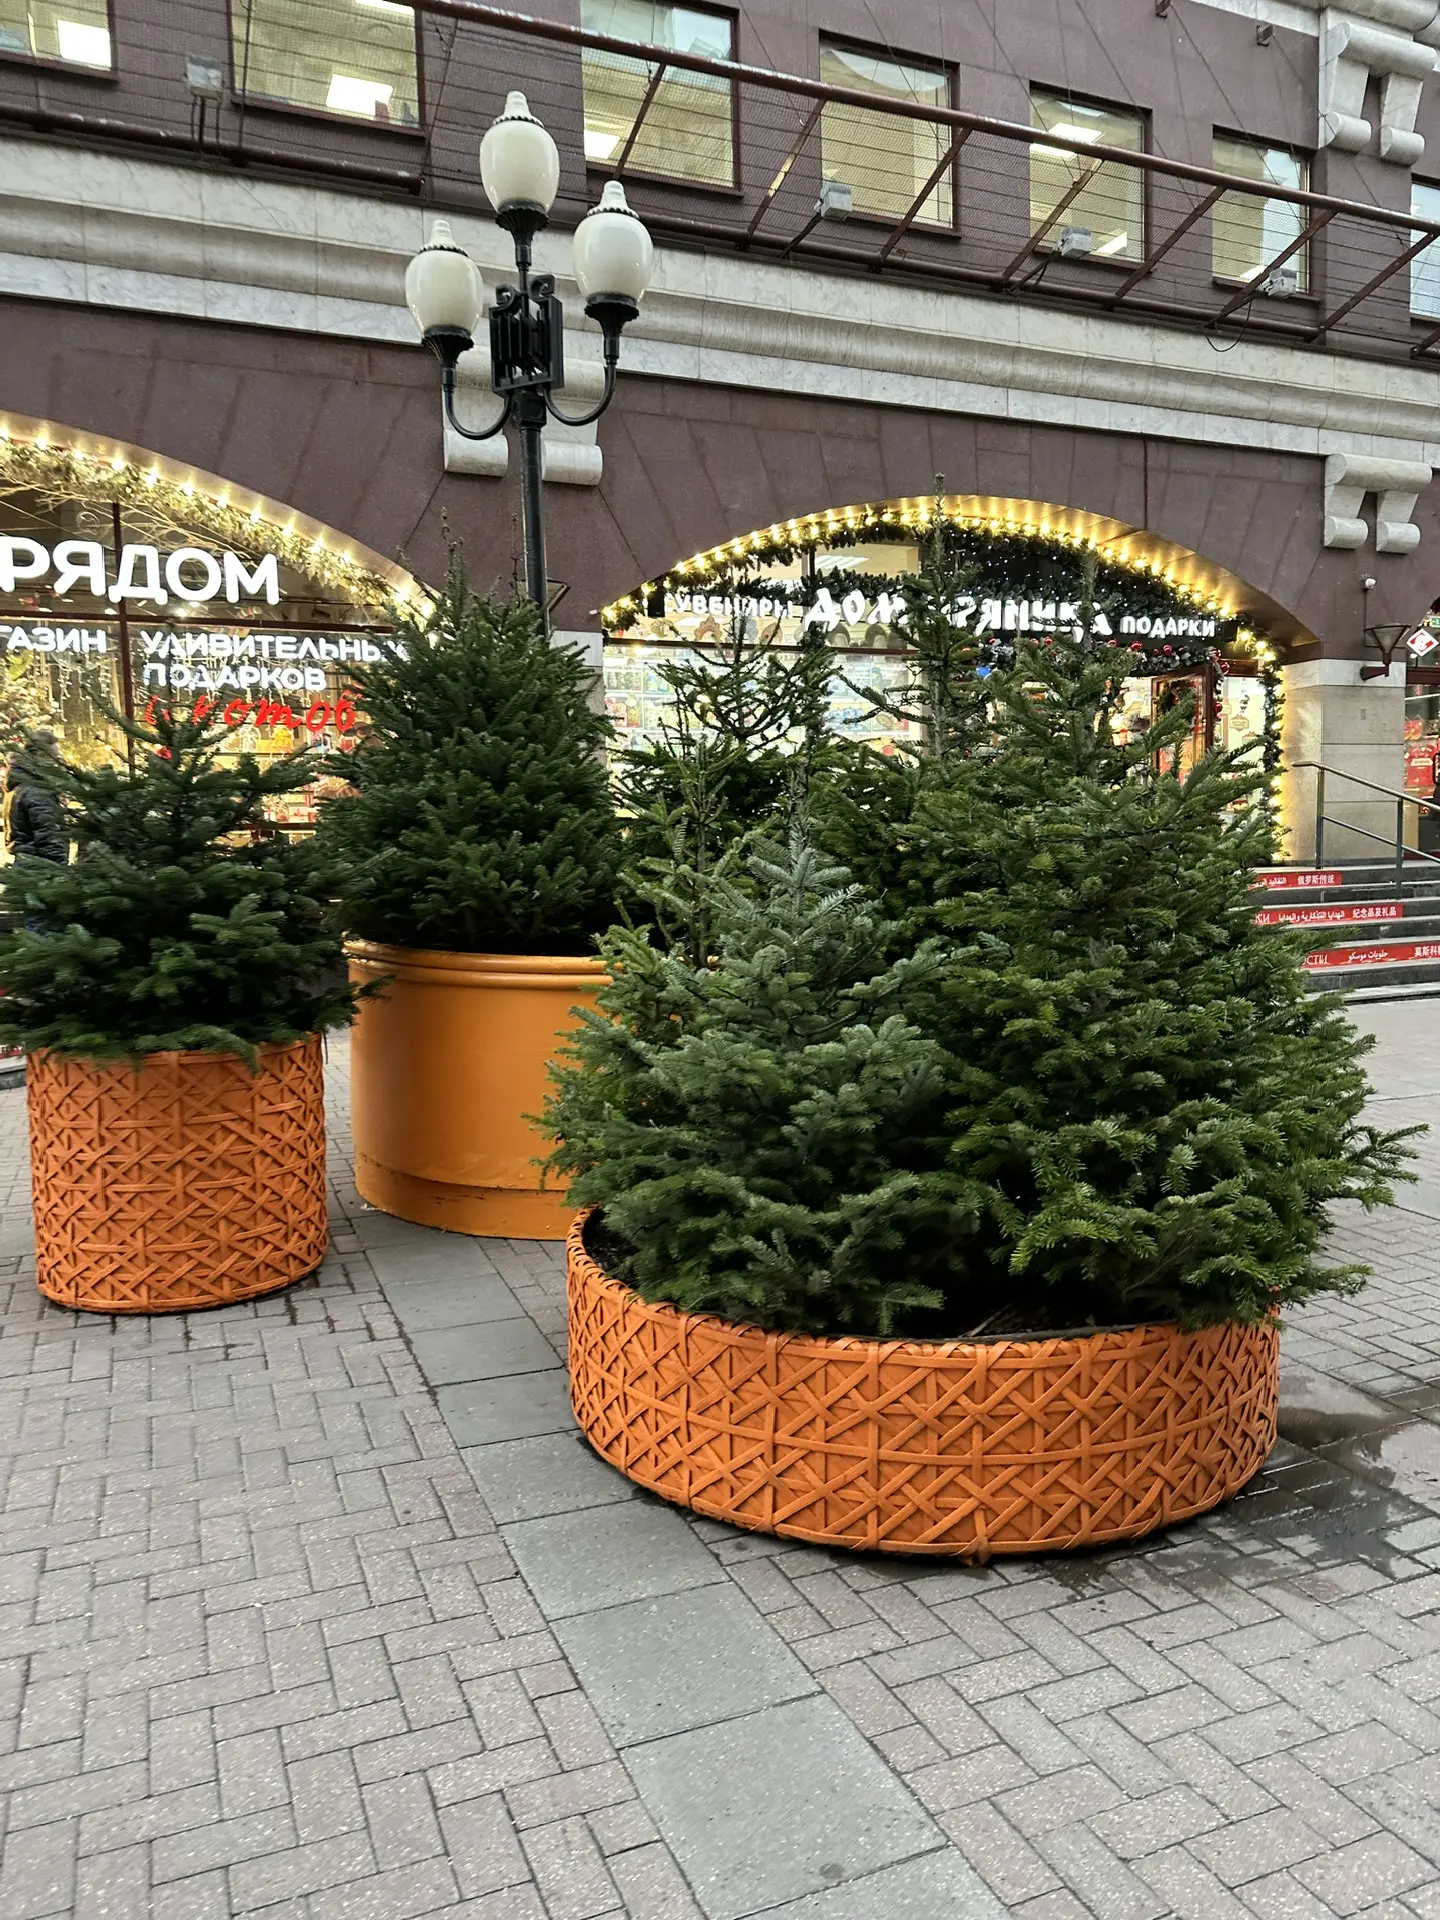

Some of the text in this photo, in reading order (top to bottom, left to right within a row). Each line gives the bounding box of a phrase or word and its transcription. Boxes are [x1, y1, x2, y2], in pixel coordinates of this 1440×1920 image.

[0, 536, 280, 606] РЯДОМ
[664, 593, 793, 619] СУВЕНИРЫ
[1120, 615, 1215, 639] ПОДАРКИ
[143, 662, 328, 692] ПОДАРКОВ
[1352, 906, 1396, 919] 纪念品及礼品
